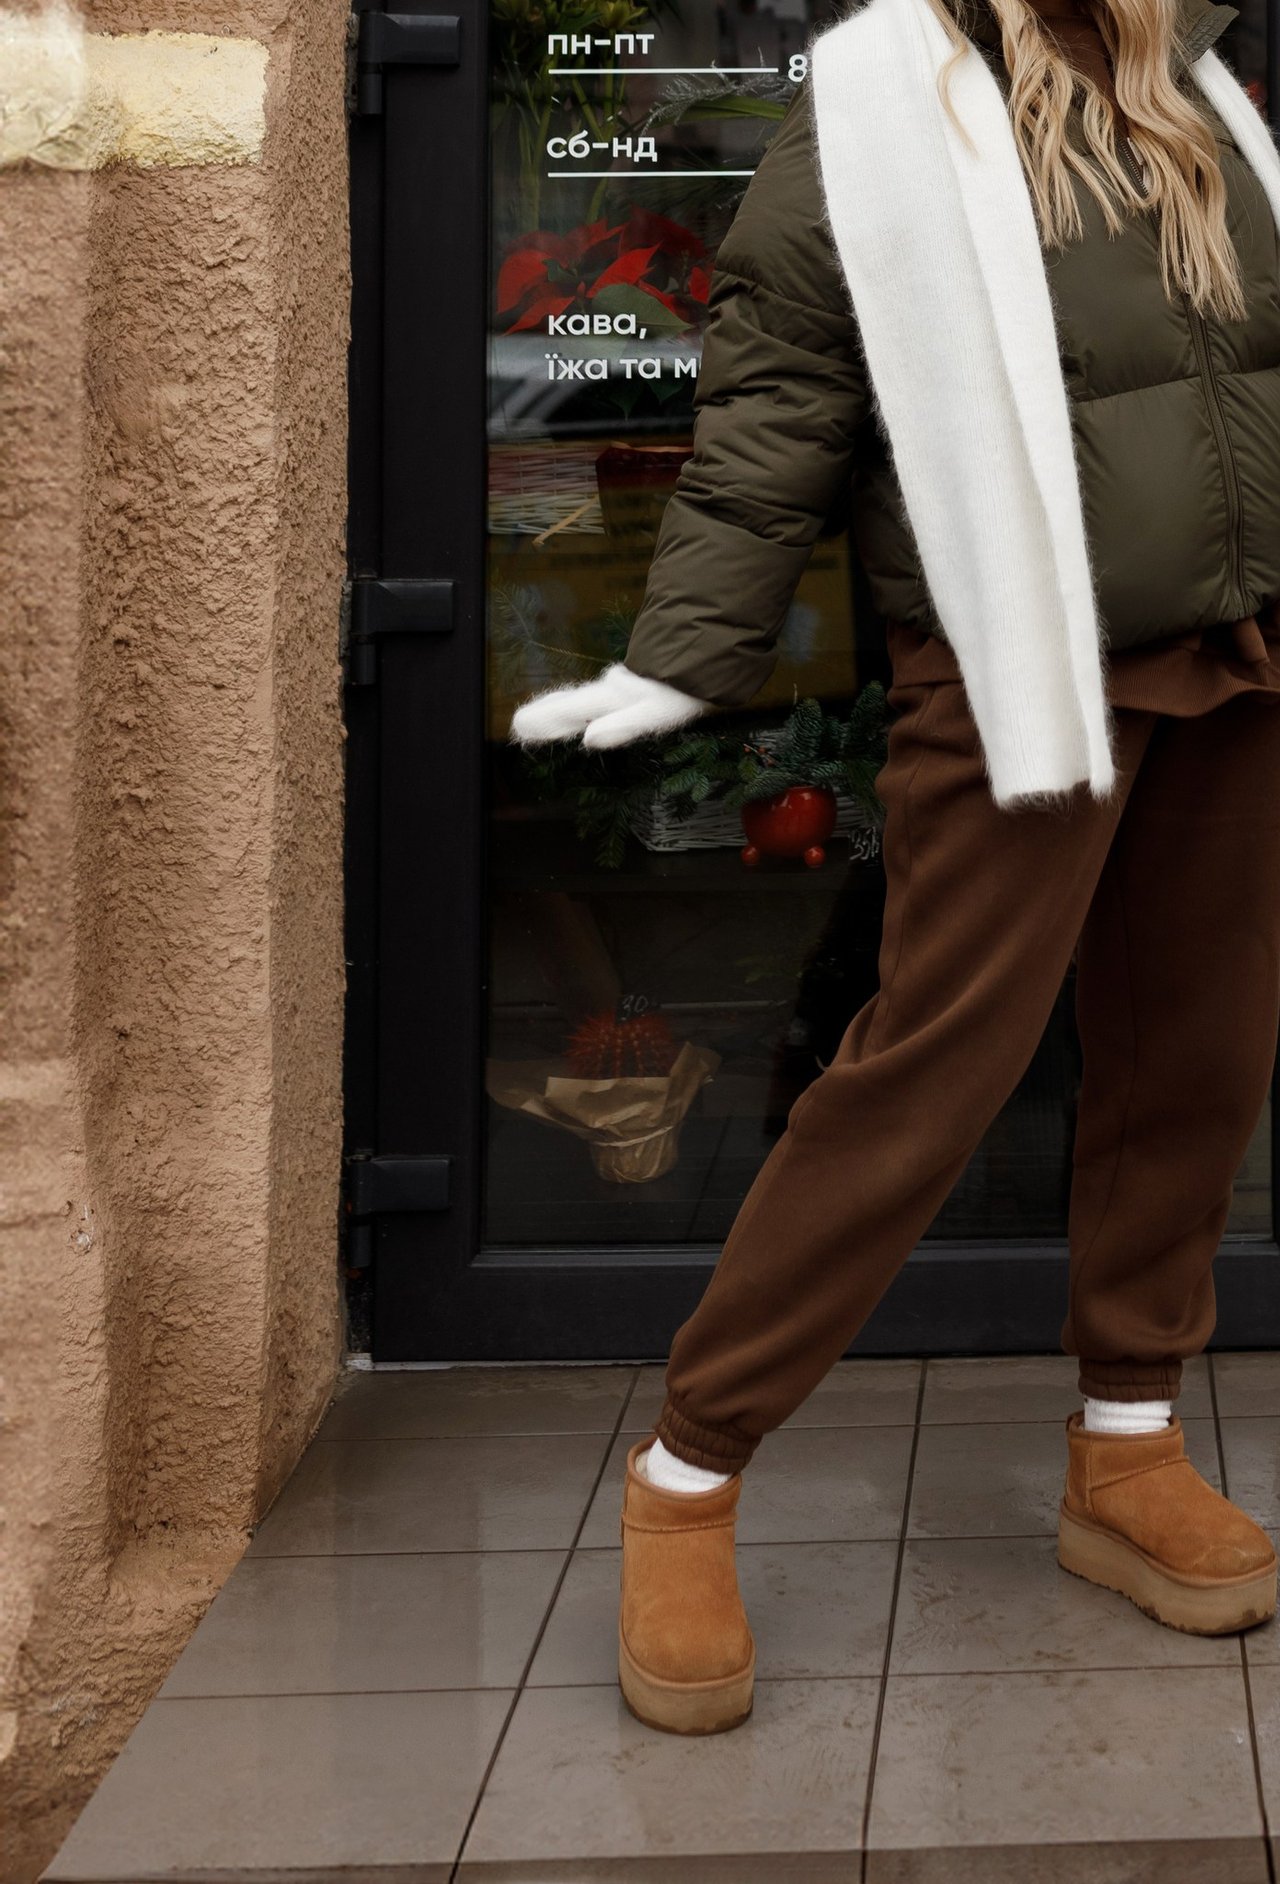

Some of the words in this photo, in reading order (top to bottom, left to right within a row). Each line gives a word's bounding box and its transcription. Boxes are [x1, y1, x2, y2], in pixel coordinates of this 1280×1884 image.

[548, 313, 647, 339] кава,
[545, 353, 608, 380] їжа
[619, 358, 661, 379] та
[674, 357, 701, 378] м
